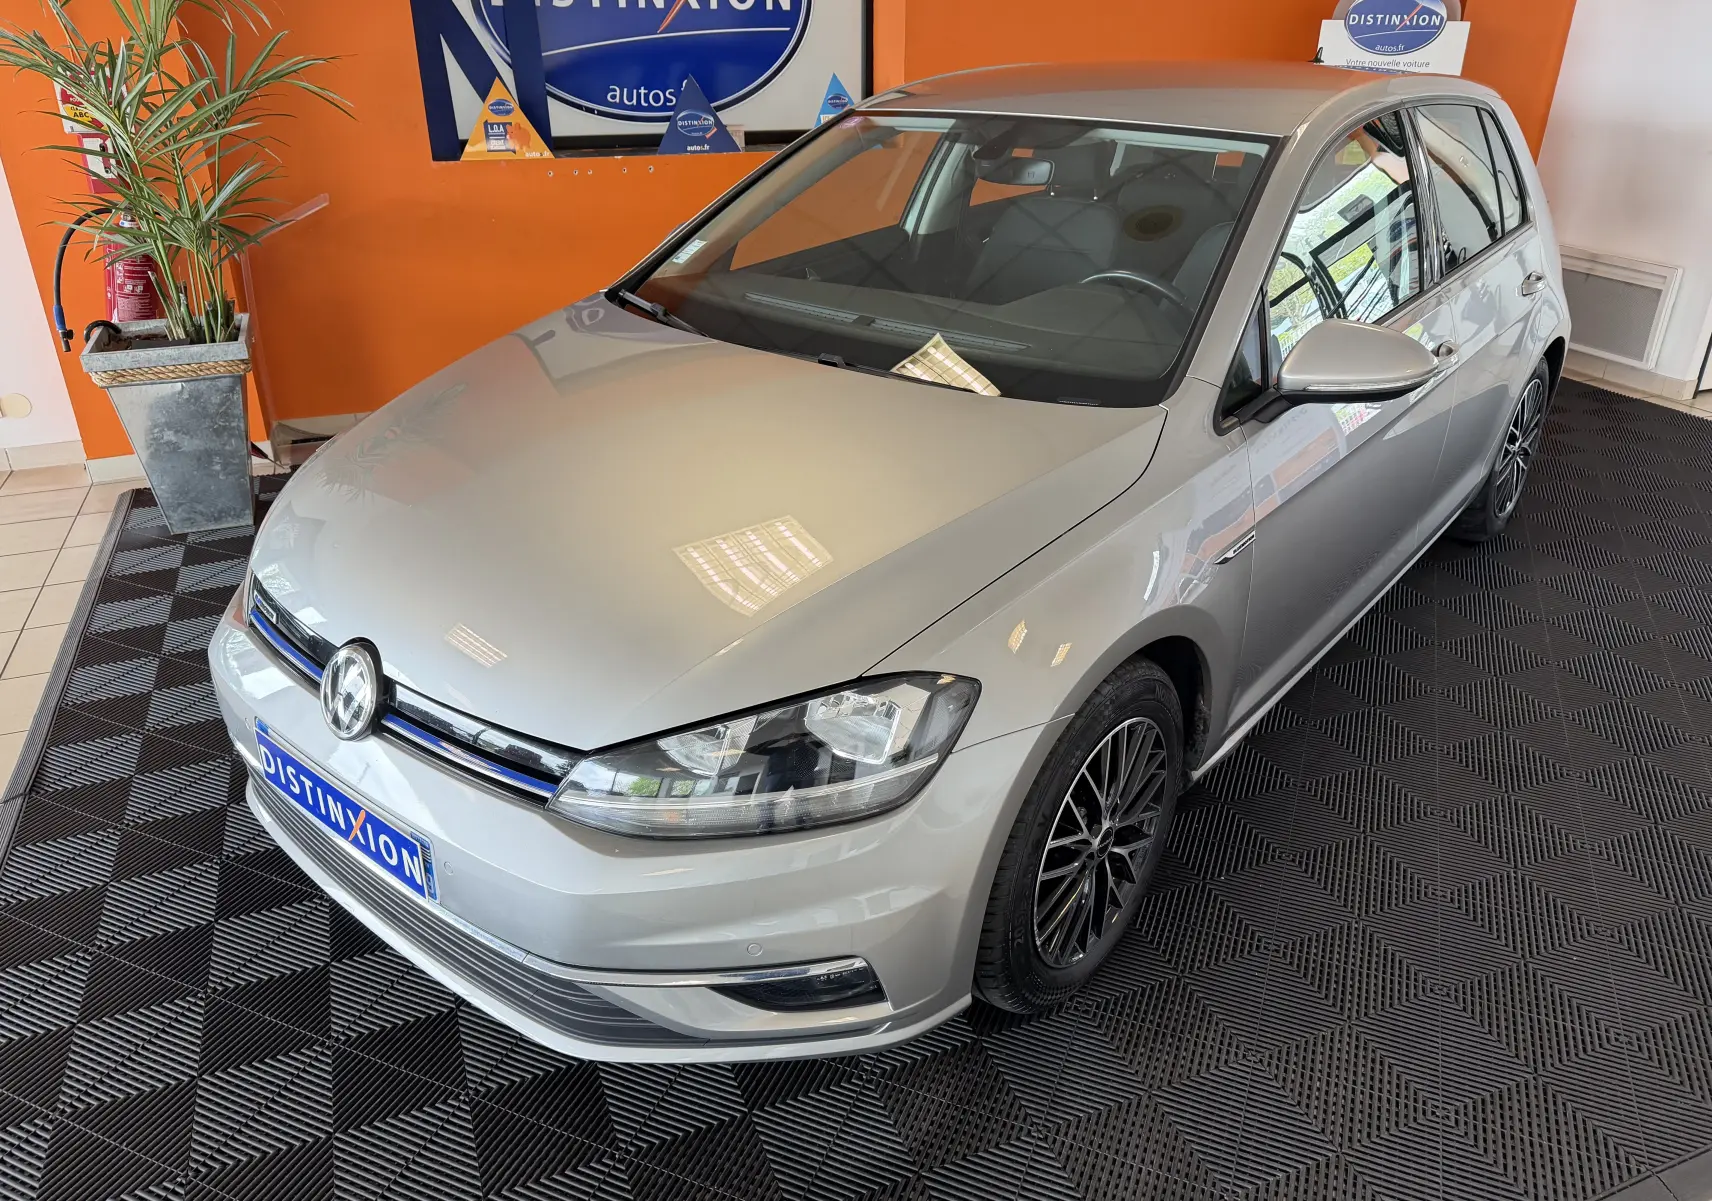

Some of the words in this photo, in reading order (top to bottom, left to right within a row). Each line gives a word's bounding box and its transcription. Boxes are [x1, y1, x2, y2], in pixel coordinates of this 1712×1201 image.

[1349, 13, 1442, 28] DISTINXION
[1374, 43, 1405, 53] autos.fr
[1345, 58, 1367, 67] Votre
[1367, 58, 1401, 68] nouvelle
[1402, 59, 1430, 68] voiture
[606, 79, 688, 107] autos
[677, 119, 713, 127] DISTINXION
[686, 143, 710, 151] autos.fr
[258, 743, 423, 886] DISTINXION
